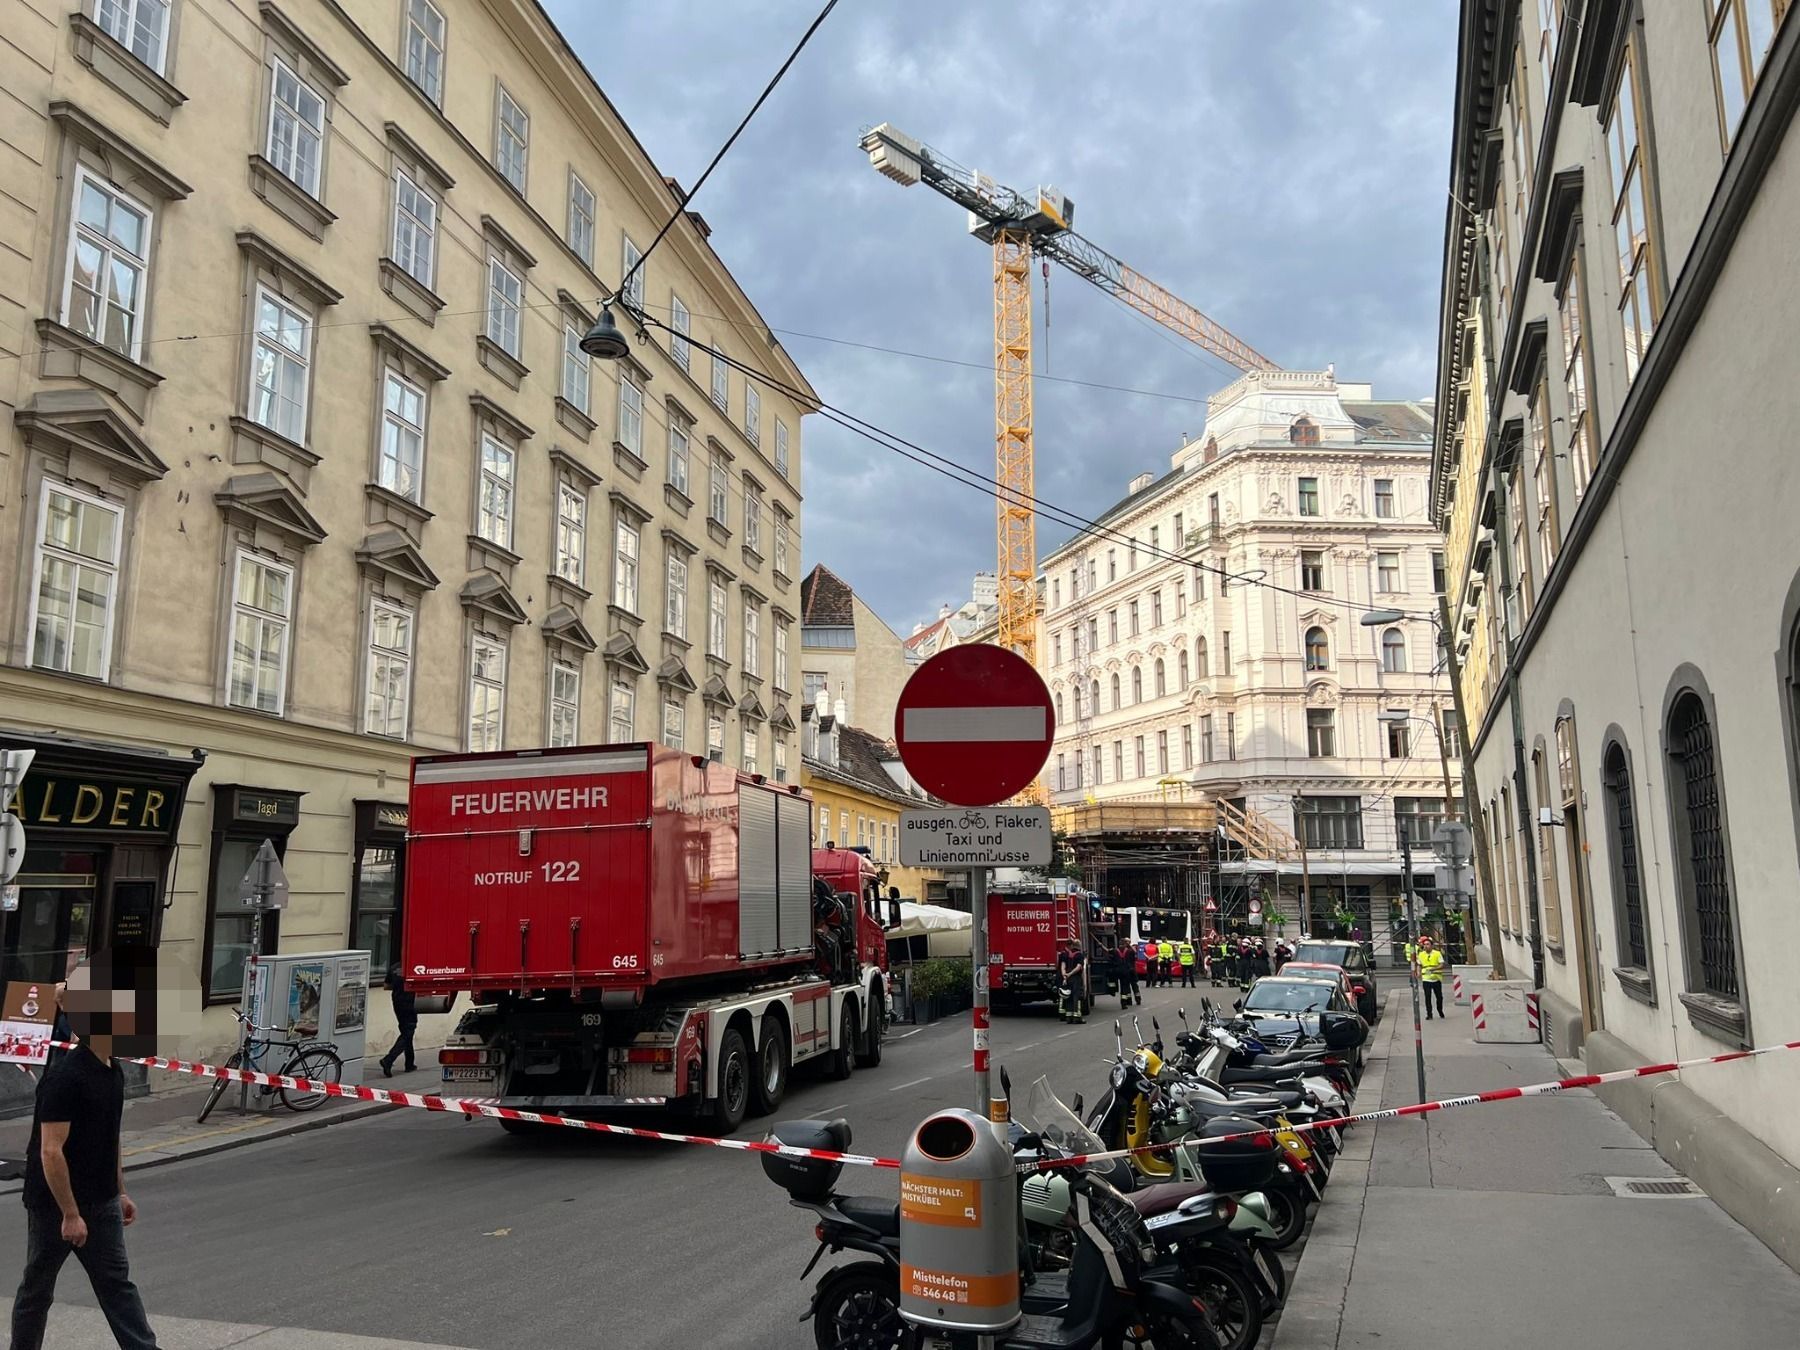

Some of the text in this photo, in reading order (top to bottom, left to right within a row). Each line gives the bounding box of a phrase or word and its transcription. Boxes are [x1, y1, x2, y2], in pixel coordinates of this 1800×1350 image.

[257, 800, 277, 817] Jagd
[451, 786, 608, 816] FEUERWEHR
[907, 817, 957, 832] ausgen.
[946, 832, 1002, 845] Taxi und
[474, 860, 581, 885] NOTRUF 122
[1007, 910, 1050, 920] FEUERWEHR
[1036, 922, 1050, 933] 122
[612, 954, 638, 968] 645
[652, 953, 664, 967] 645
[426, 965, 466, 975] rosenbauer
[581, 1014, 601, 1026] 169
[902, 1180, 964, 1197] NÄCHSTER HALT:
[902, 1191, 941, 1206] MISTKÜBEL
[912, 1269, 968, 1288] Misttelefon
[923, 1286, 956, 1301] 546 48
